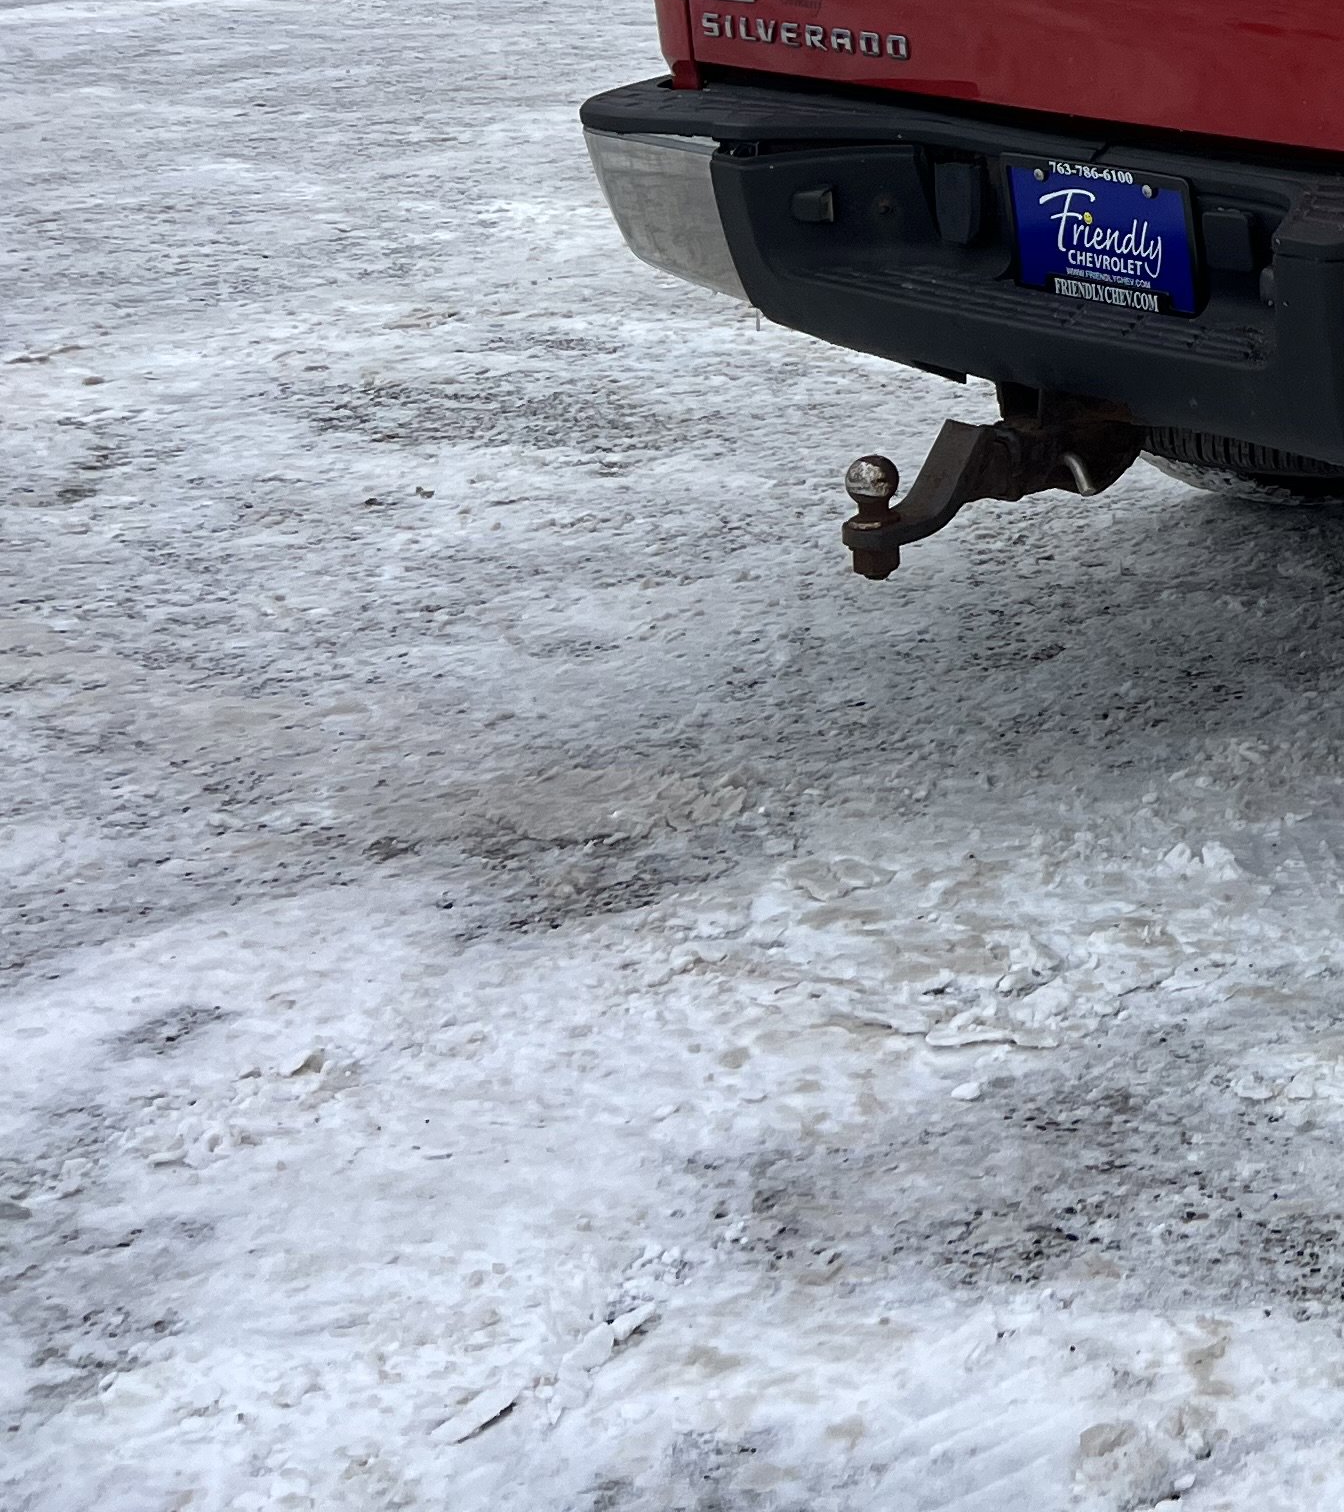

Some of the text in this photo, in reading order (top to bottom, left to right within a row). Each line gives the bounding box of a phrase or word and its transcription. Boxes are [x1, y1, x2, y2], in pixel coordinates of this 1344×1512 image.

[702, 12, 909, 60] SILVERADO
[1048, 161, 1134, 185] 763-786-6100
[1039, 188, 1162, 279] Friendly
[1067, 249, 1143, 276] CHEVROLET
[1053, 277, 1160, 313] FRIENDLYCHEV.COM
